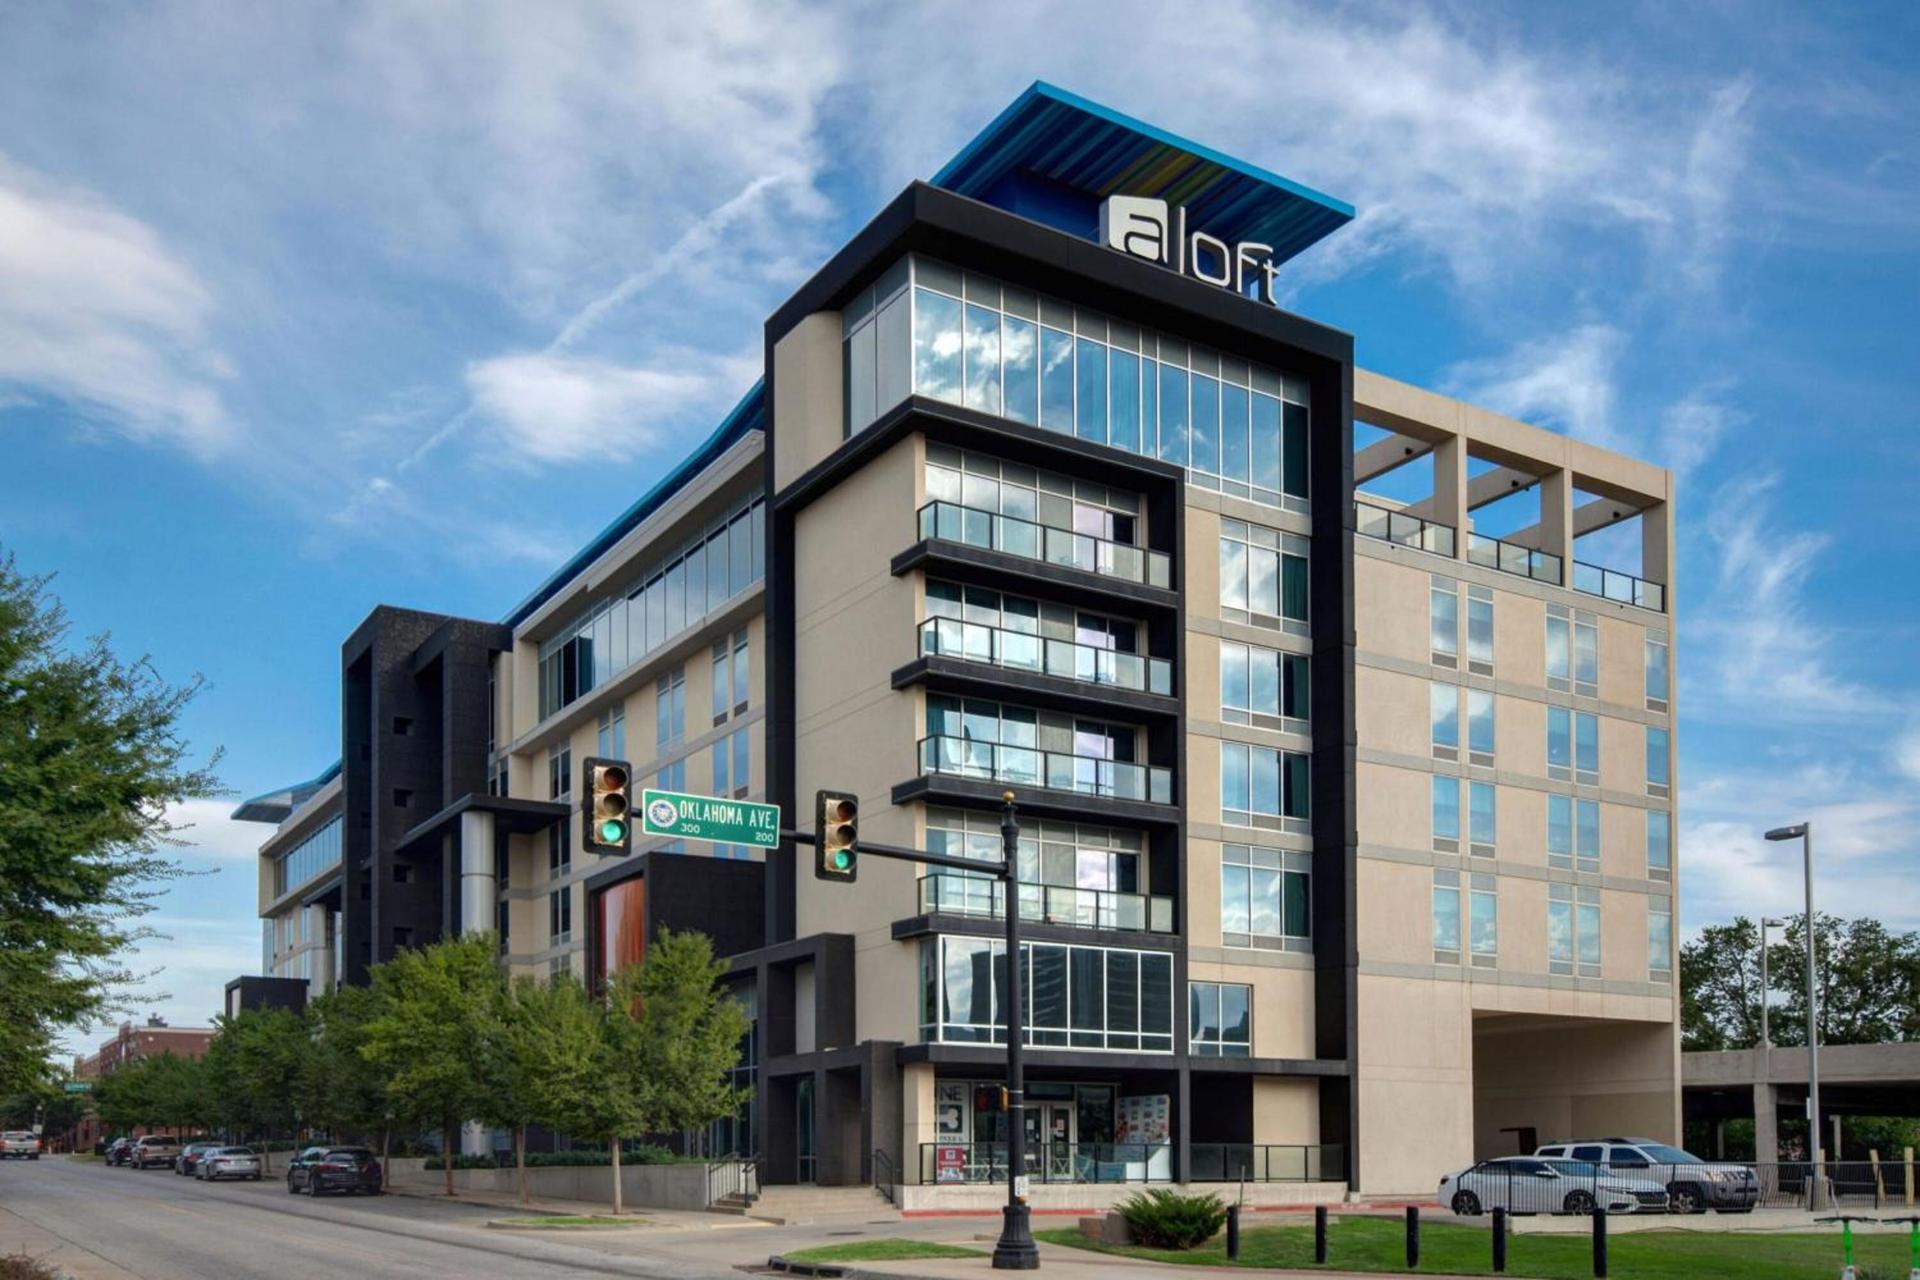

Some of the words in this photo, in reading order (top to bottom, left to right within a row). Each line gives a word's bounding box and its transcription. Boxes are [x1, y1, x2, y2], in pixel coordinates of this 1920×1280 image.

[1107, 194, 1281, 306] aloft
[680, 800, 743, 826] OKLAHOMA
[681, 823, 700, 834] 300
[755, 832, 774, 843] 200
